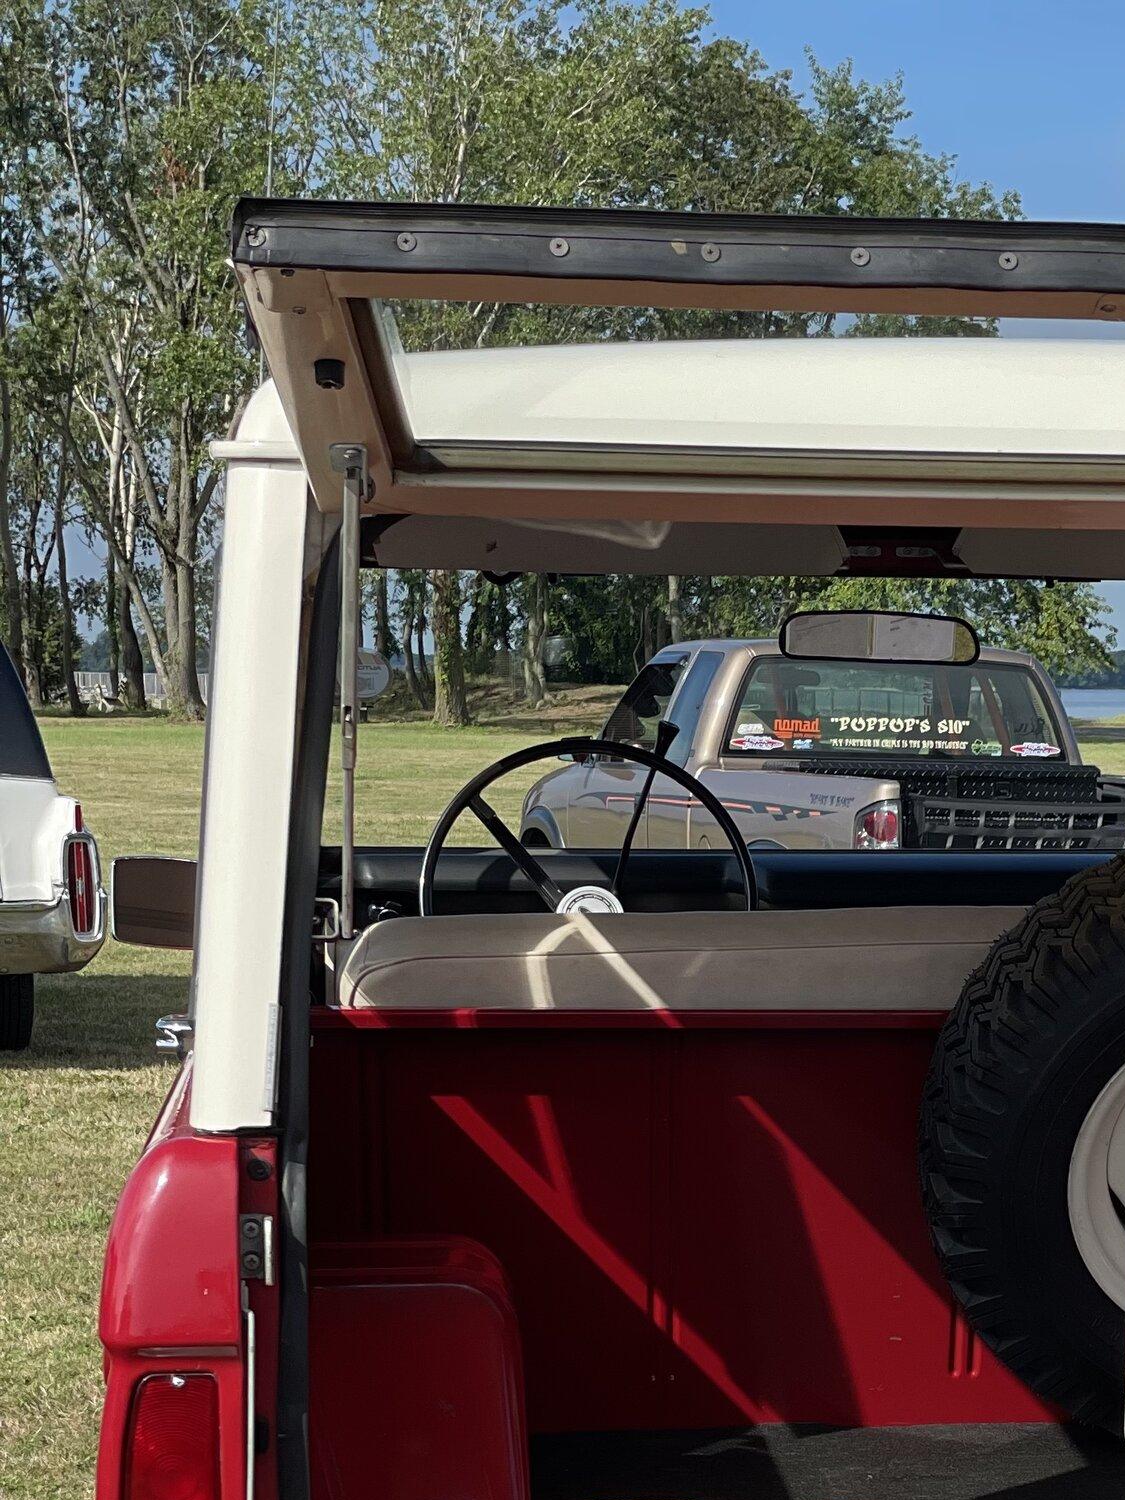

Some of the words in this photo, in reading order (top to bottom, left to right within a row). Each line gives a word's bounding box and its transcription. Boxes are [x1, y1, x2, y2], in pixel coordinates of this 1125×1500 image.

[774, 717, 821, 732] nomad
[845, 738, 872, 747] PARTNER
[873, 739, 880, 748] IN
[902, 740, 908, 748] IS
